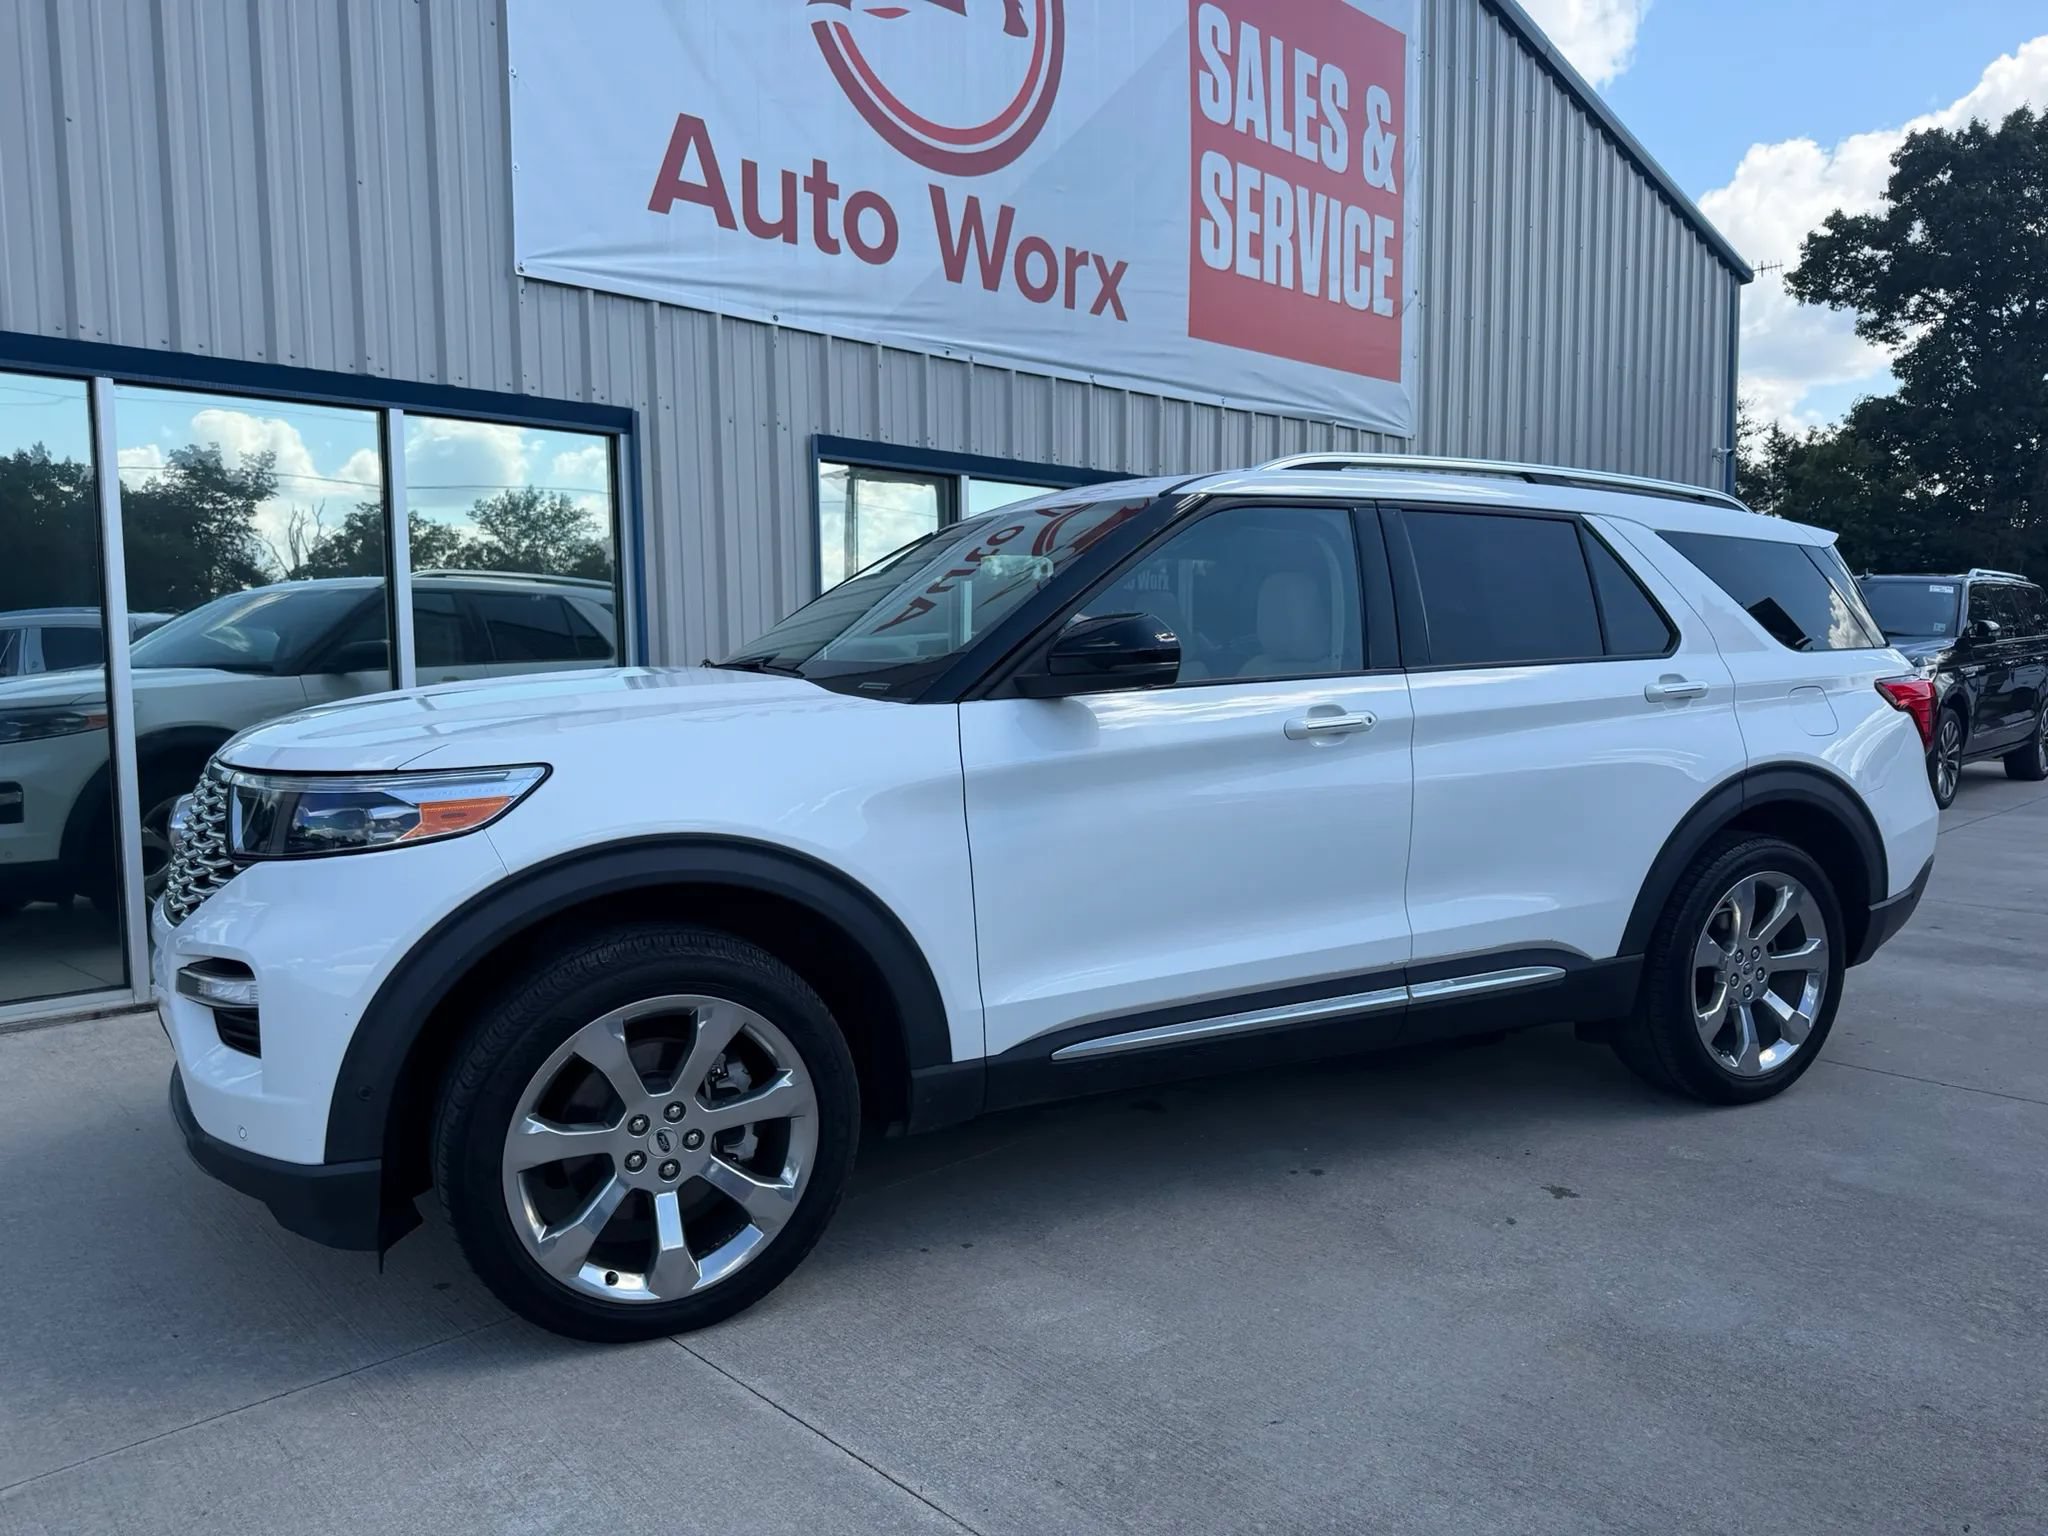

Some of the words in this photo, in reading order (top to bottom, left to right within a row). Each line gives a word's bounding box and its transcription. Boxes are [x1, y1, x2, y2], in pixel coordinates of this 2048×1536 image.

[1199, 2, 1348, 174] SALES
[1361, 84, 1397, 194] &
[648, 113, 899, 265] Auto
[928, 184, 1128, 323] Worx
[1200, 149, 1395, 318] SERVICE
